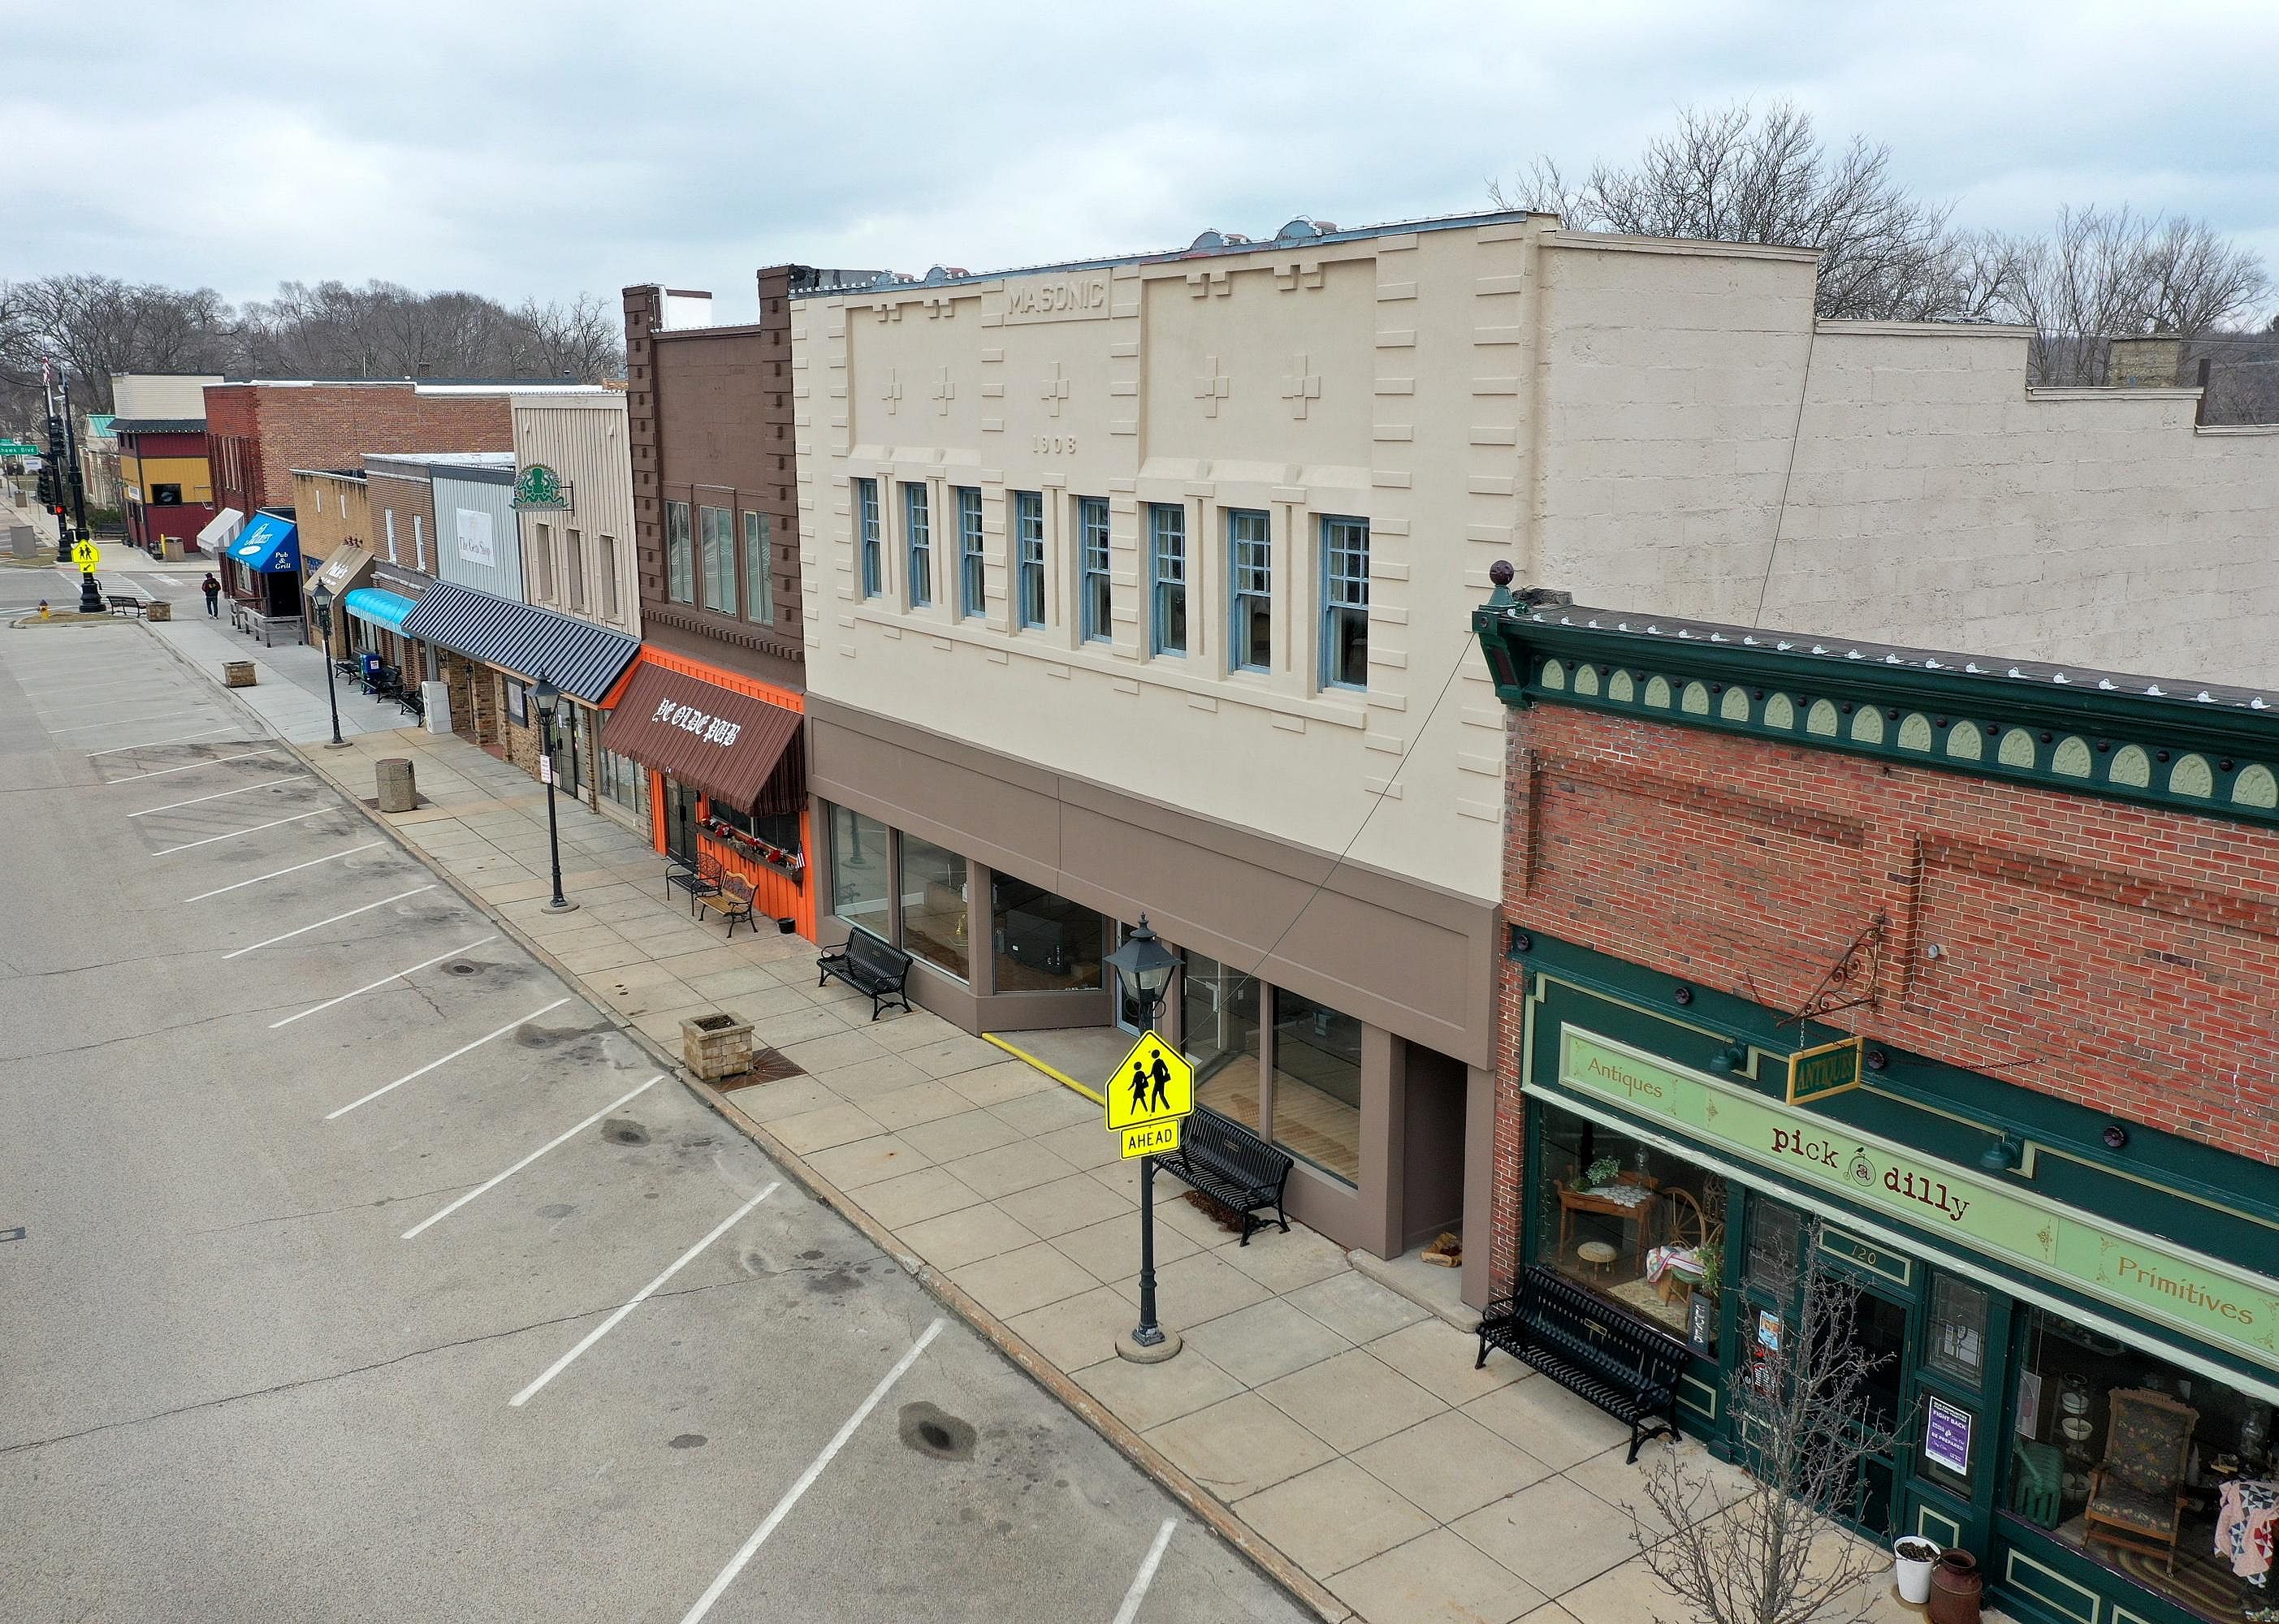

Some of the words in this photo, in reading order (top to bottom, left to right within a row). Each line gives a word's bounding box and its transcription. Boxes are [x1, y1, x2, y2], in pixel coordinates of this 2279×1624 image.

[1007, 280, 1105, 314] MASONIC
[1032, 434, 1077, 455] 1908
[1588, 1057, 1663, 1099] Antiques
[1128, 1129, 1172, 1151] AHEAD
[1771, 1128, 1839, 1168] pick
[1883, 1167, 1970, 1222] dilly
[1851, 1245, 1876, 1266] 120
[2118, 1256, 2253, 1325] Primitives
[1933, 1410, 1950, 1422] FIGHT
[1950, 1419, 1966, 1430] BACK
[1939, 1435, 1964, 1451] PREPARED
